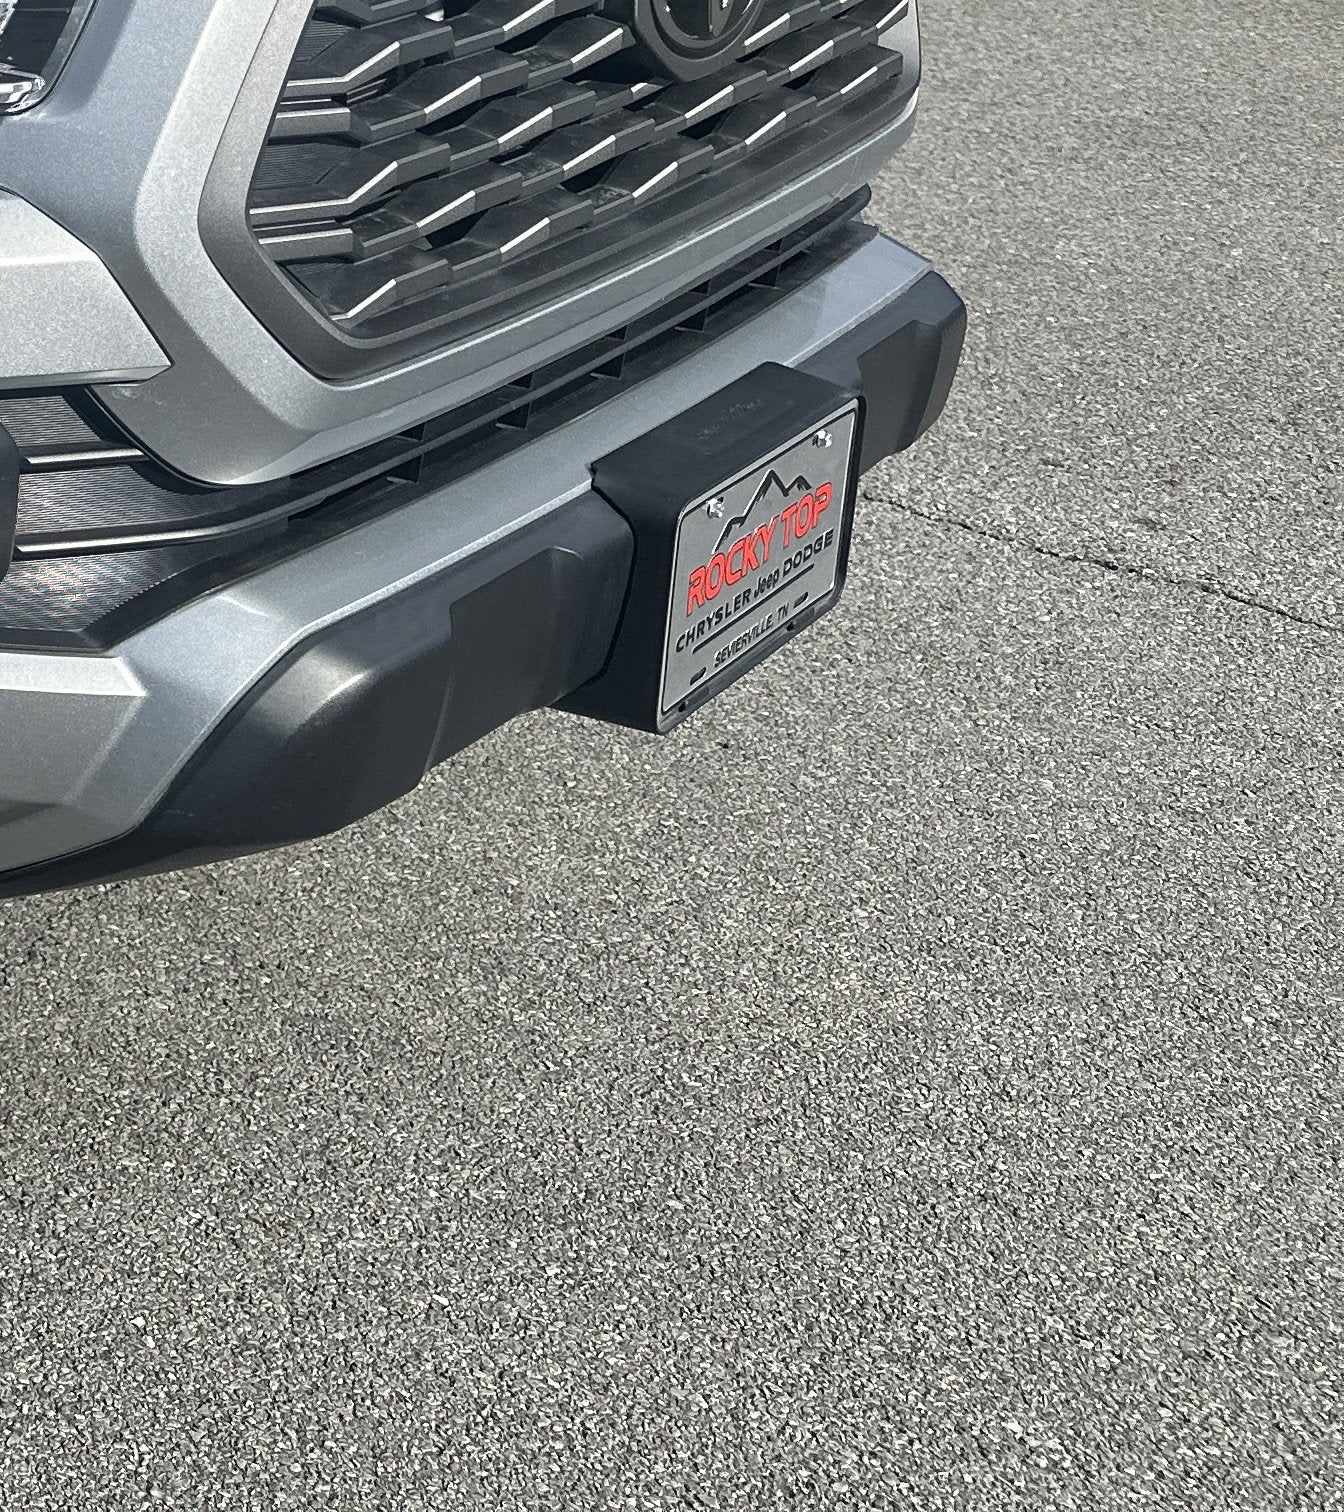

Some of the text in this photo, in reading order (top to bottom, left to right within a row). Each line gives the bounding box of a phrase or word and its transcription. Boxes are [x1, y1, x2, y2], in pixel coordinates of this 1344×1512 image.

[675, 528, 834, 653] CHRYSLER Jeep DODGE
[686, 481, 833, 618] ROCKY TOP
[778, 602, 790, 620] TN
